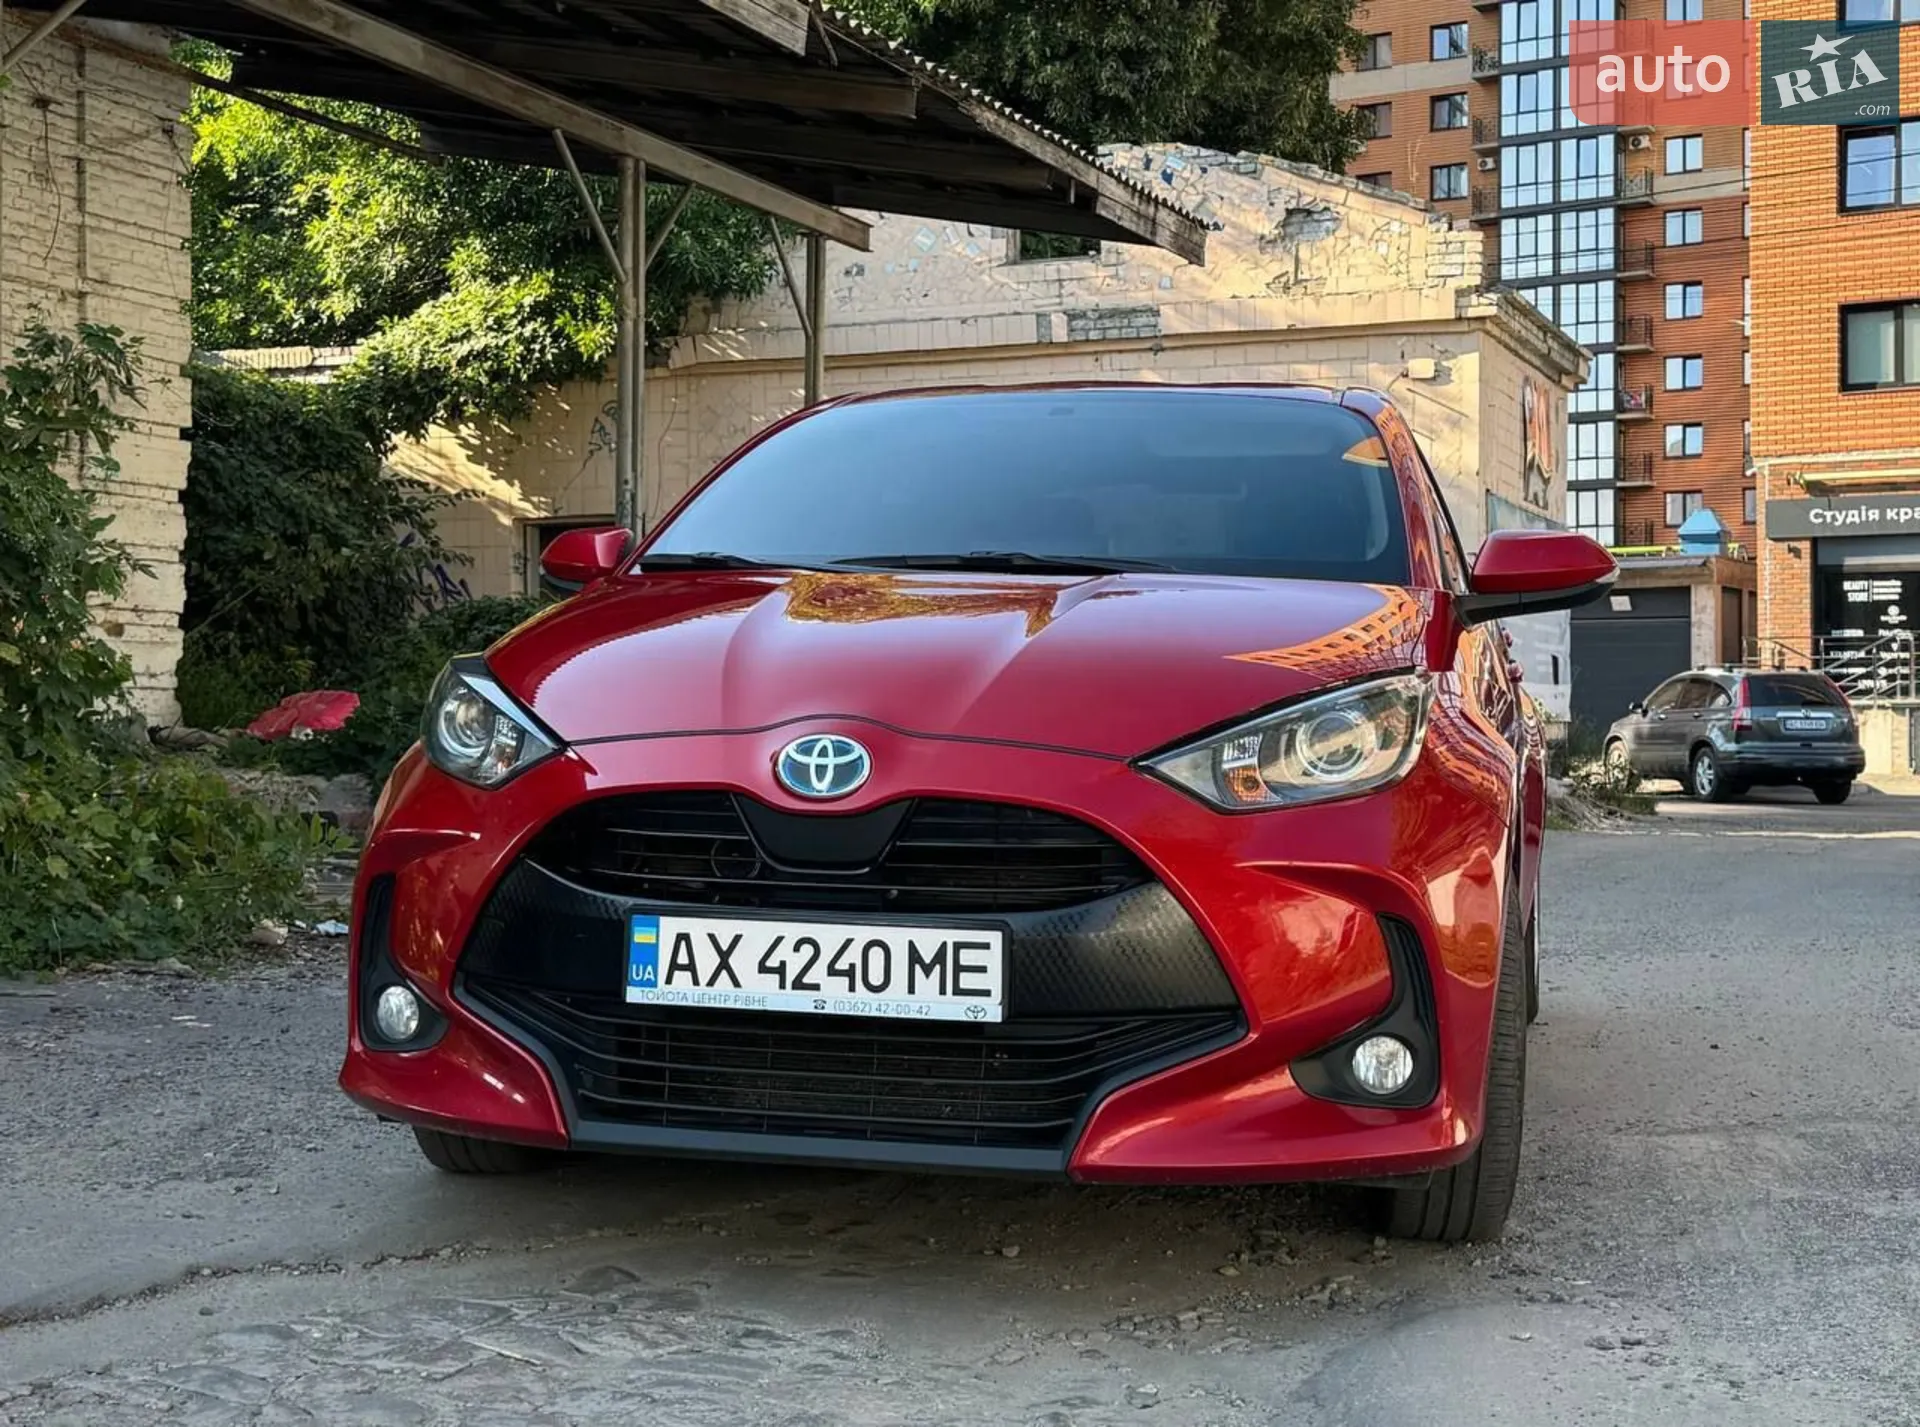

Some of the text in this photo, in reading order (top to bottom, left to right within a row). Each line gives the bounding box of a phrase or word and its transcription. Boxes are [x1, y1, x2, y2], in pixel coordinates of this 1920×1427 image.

[1809, 505, 1880, 526] Студія
[632, 964, 655, 981] UA
[664, 932, 992, 997] AX 4240 ME
[692, 993, 730, 1005] ЦЕНТР
[734, 995, 768, 1007] РІВНЕ
[833, 1000, 872, 1013] (0362)
